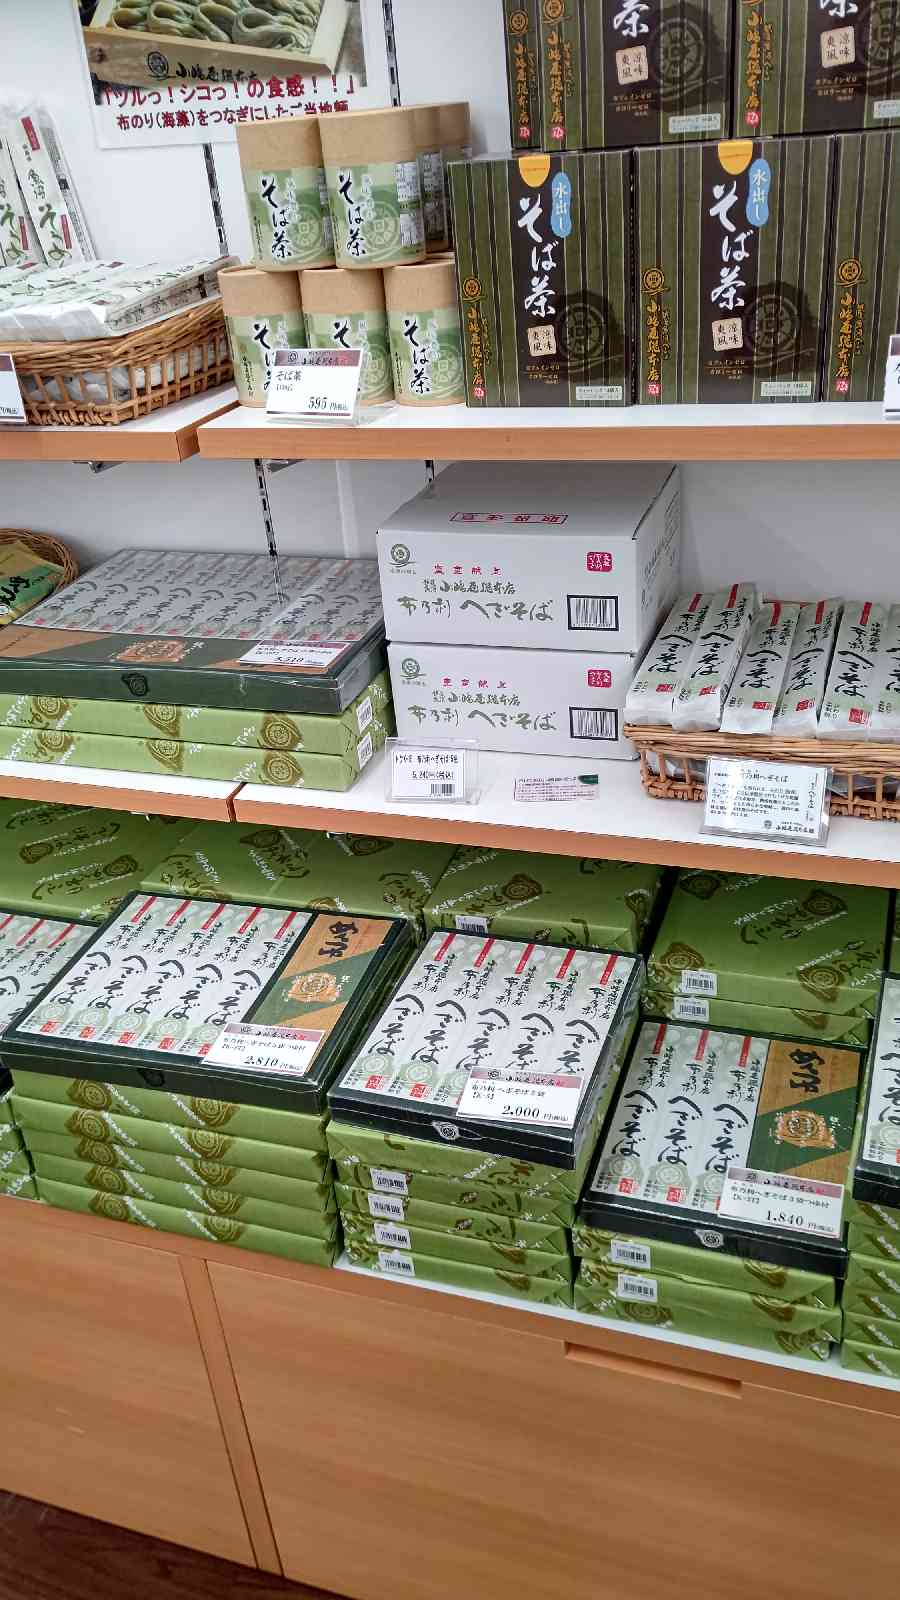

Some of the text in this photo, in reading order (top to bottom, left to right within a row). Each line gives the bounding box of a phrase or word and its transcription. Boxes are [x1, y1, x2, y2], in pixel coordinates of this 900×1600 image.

[261, 176, 292, 258] そば茶
[338, 174, 366, 257] そば茶
[553, 183, 568, 232] 水出し
[751, 169, 768, 220] 水出し
[518, 193, 559, 318] そば茶
[709, 181, 754, 311] そば茶
[404, 319, 431, 394] そば茶
[308, 396, 328, 409] 595
[459, 599, 554, 621] へぎそば
[648, 634, 693, 672] へぎそば
[691, 632, 735, 679] へぎそば
[740, 650, 782, 688] へぎそば
[785, 648, 825, 695] へぎそば
[835, 651, 875, 699] へぎそば
[468, 709, 557, 730] へぎそば
[50, 951, 111, 1005] へぎそば
[88, 955, 148, 1009] へぎそば
[125, 959, 185, 1014] へぎそば
[164, 963, 223, 1020] へぎそば
[204, 969, 262, 1026] へぎそば
[368, 993, 424, 1056] へぎそば
[411, 1000, 467, 1065] へぎそば
[456, 1008, 511, 1070] へぎそば
[612, 1090, 658, 1157] へぎそば
[658, 1096, 703, 1166] へぎそば
[705, 1103, 749, 1174] へぎそば
